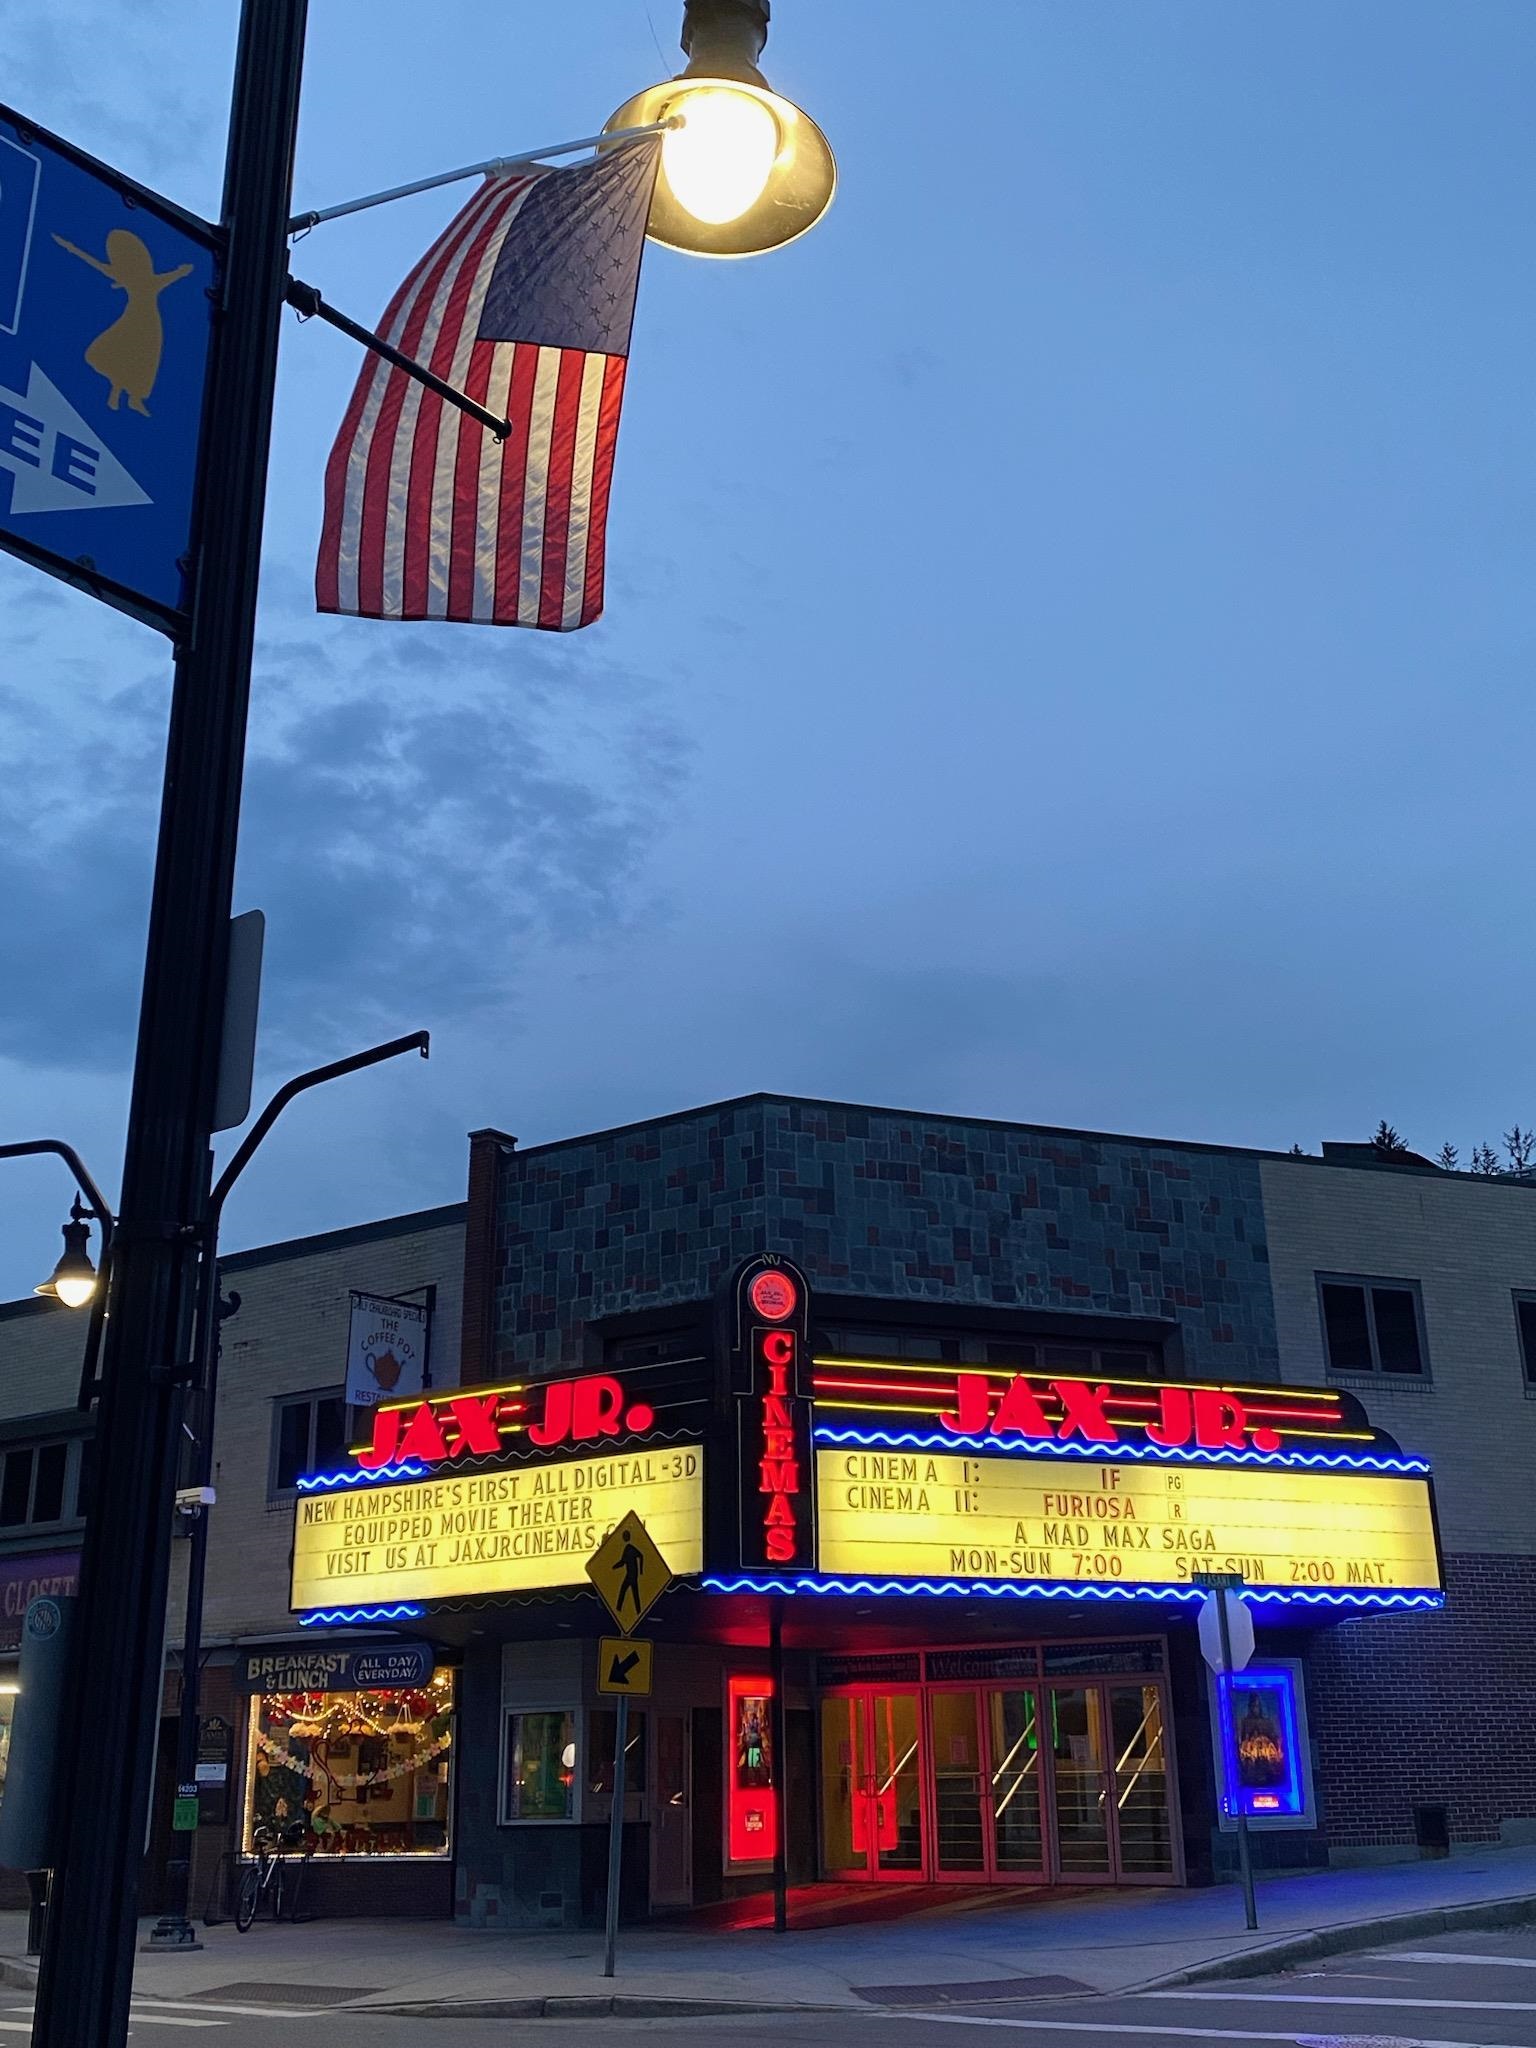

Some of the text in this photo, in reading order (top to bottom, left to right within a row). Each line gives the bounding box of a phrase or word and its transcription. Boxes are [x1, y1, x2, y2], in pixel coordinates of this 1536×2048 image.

[381, 1318, 399, 1332] THE
[361, 1332, 415, 1359] COFFEE POT
[358, 1376, 654, 1470] JAX JR.
[940, 1373, 1281, 1452] JAX JR.
[759, 1333, 799, 1560] CINEMAS
[845, 1455, 1181, 1490] CINEMA I: IF PG
[304, 1500, 336, 1524] NEW
[343, 1484, 462, 1519] HAMPSHIRE'S
[468, 1476, 520, 1504] FIRST
[533, 1470, 568, 1496] ALL
[574, 1459, 656, 1491] DIGITAL
[847, 1486, 1182, 1520] CINEMA II: FURIOSA R
[344, 1496, 593, 1546] EQUIPPED MOVIE THEATER
[1014, 1521, 1216, 1551] A MAD MAX SAGA
[327, 1551, 370, 1575] VISIT
[386, 1547, 407, 1569] US
[415, 1543, 437, 1567] AT
[950, 1549, 1394, 1584] MON-SUN 7:00 SAT-SUN 2:00 MAT.
[248, 1654, 350, 1681] BREAKFAST
[360, 1658, 381, 1669] ALL
[266, 1676, 276, 1689] &
[278, 1671, 328, 1689] LUNCH
